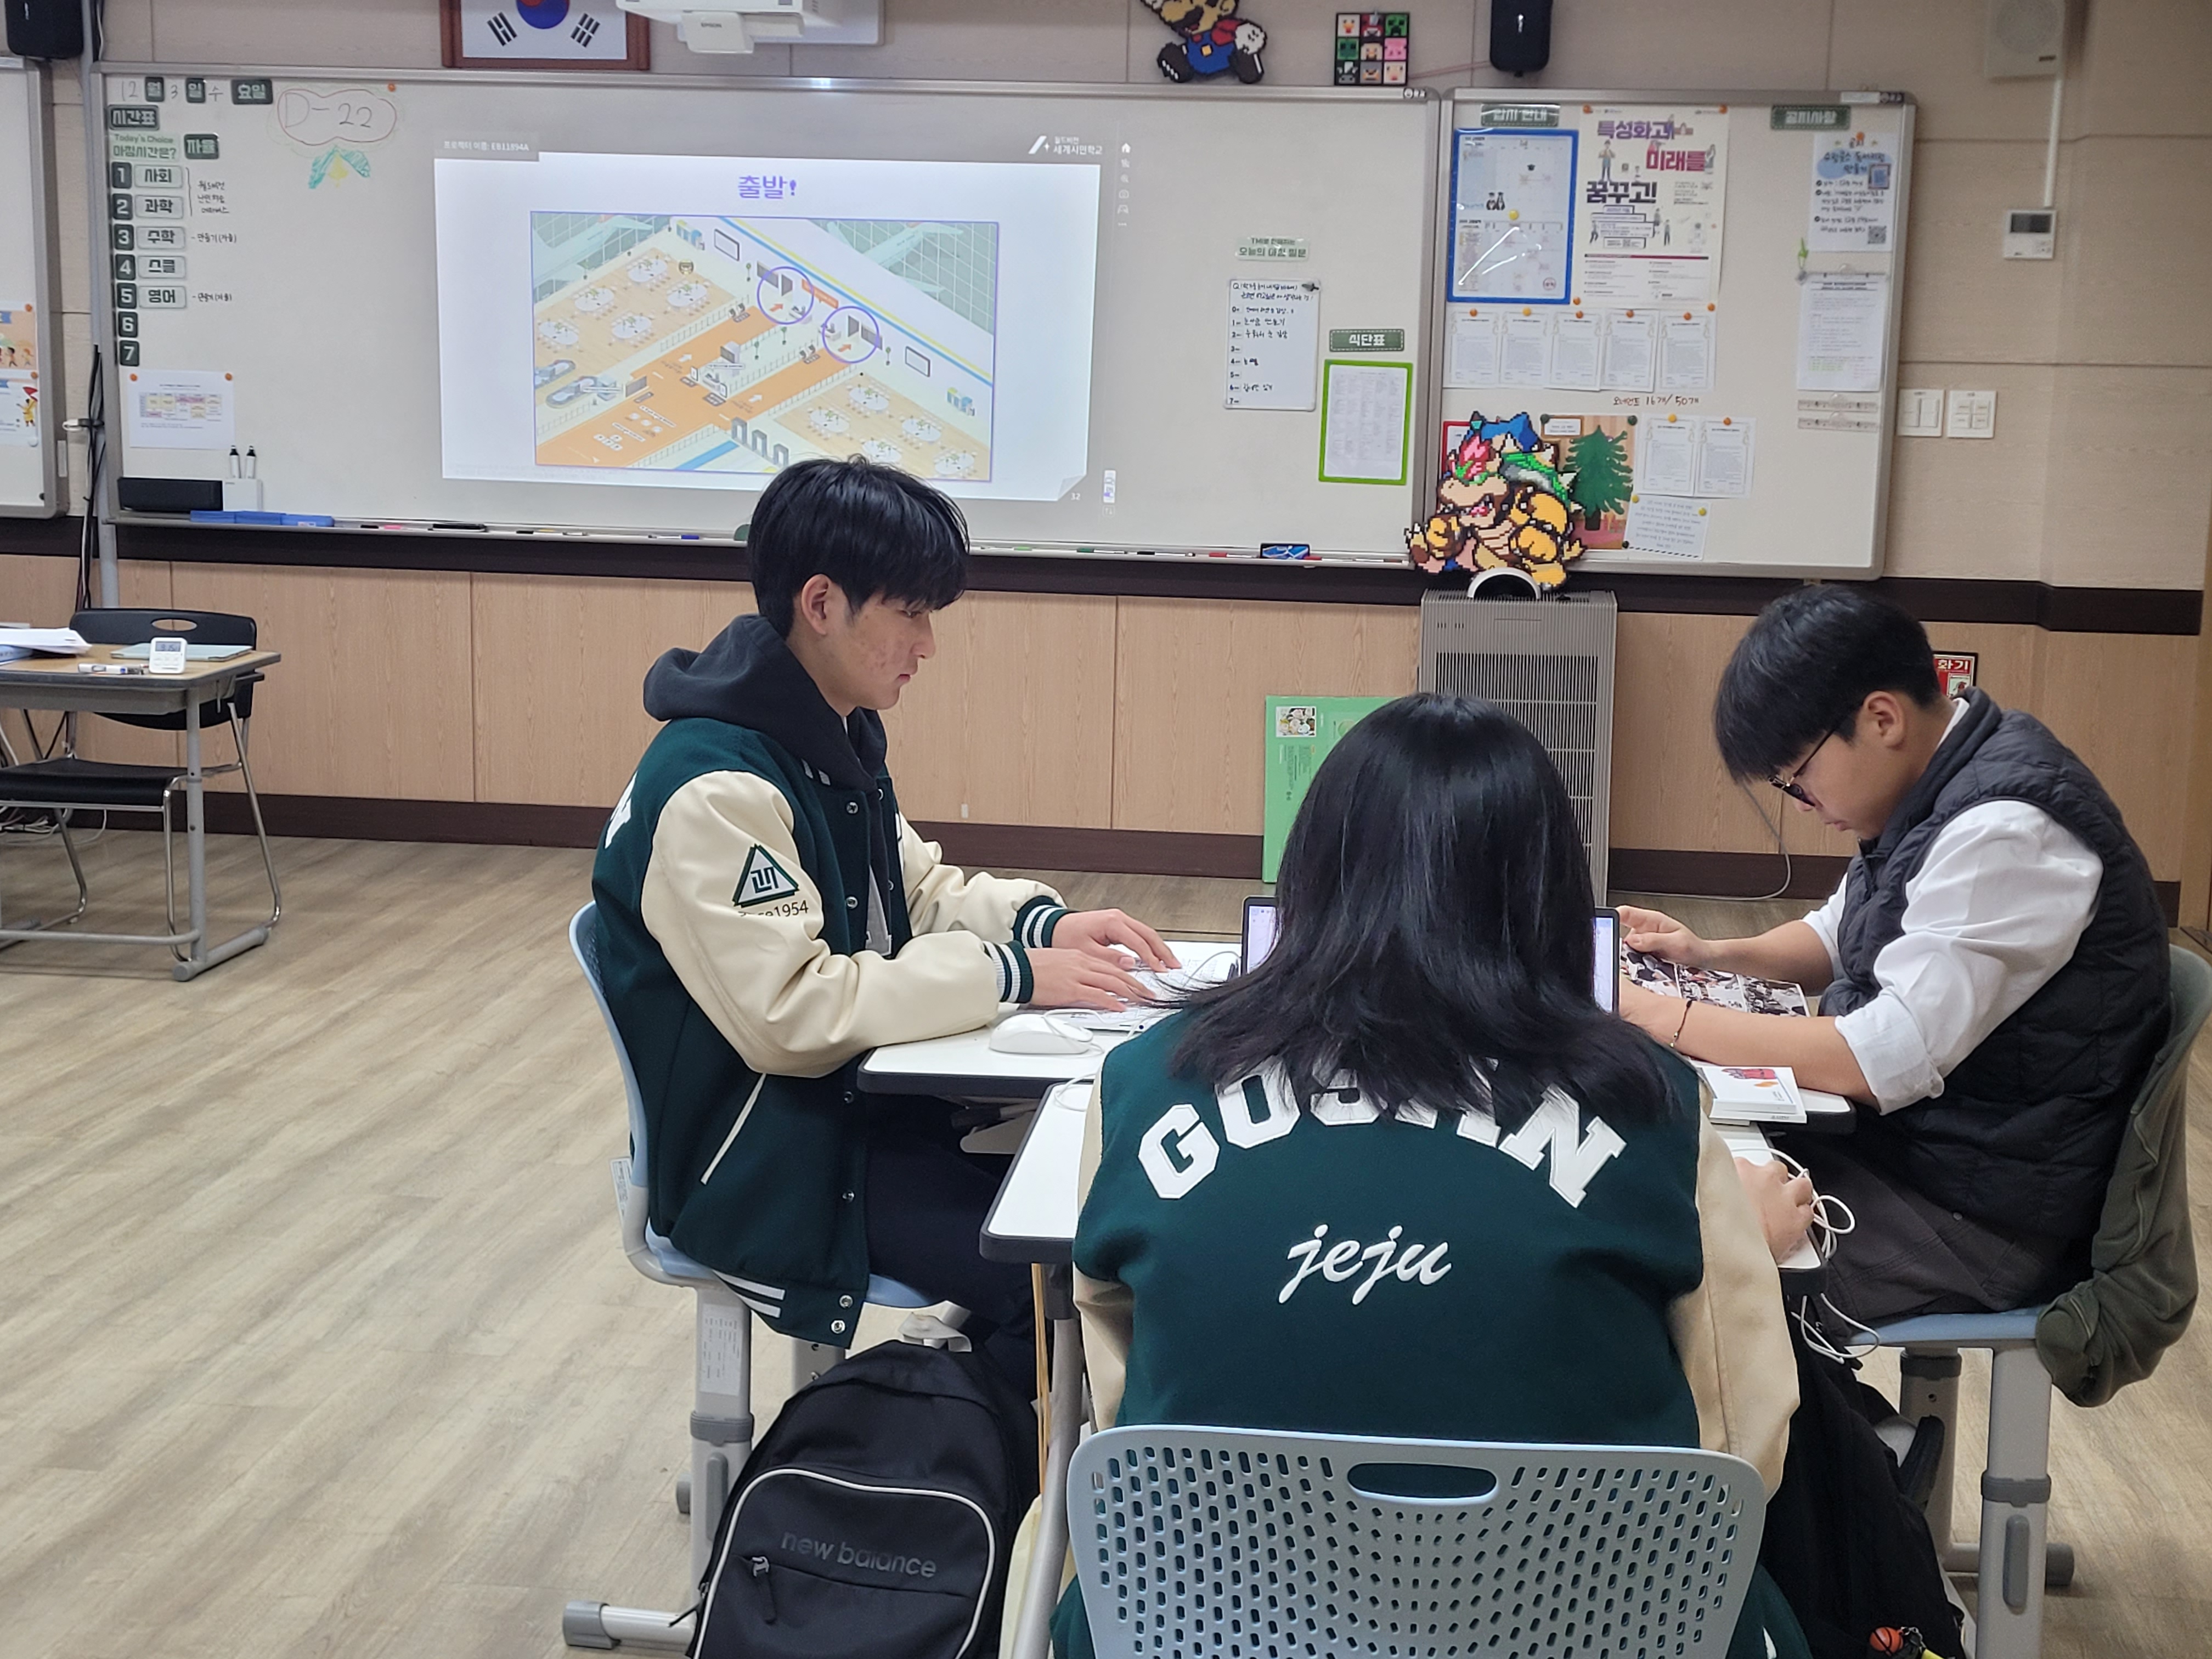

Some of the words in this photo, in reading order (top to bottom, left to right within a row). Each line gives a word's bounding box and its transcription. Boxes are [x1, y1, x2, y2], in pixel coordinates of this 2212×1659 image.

[238, 84, 266, 99] 요일
[112, 110, 156, 125] 시간표
[114, 134, 144, 144] Today's
[146, 135, 173, 144] Choice
[1646, 147, 1706, 172] 미래를
[117, 167, 125, 183] 1
[144, 168, 172, 183] 사회
[738, 175, 797, 199] 출발!
[116, 199, 129, 215] 2
[144, 199, 173, 213] 과학
[118, 229, 129, 244] 3
[148, 230, 175, 244] 수학
[120, 259, 131, 274] 4
[121, 288, 133, 303] 5
[148, 289, 176, 303] 영어
[122, 317, 134, 332] 6
[1349, 334, 1385, 346] 식단표
[123, 346, 135, 360] 7
[1938, 659, 1969, 670] 화기
[1138, 1056, 1628, 1208] GOSN
[1278, 1224, 1452, 1306] jeju
[781, 1532, 834, 1560] new
[837, 1541, 937, 1578] balance
